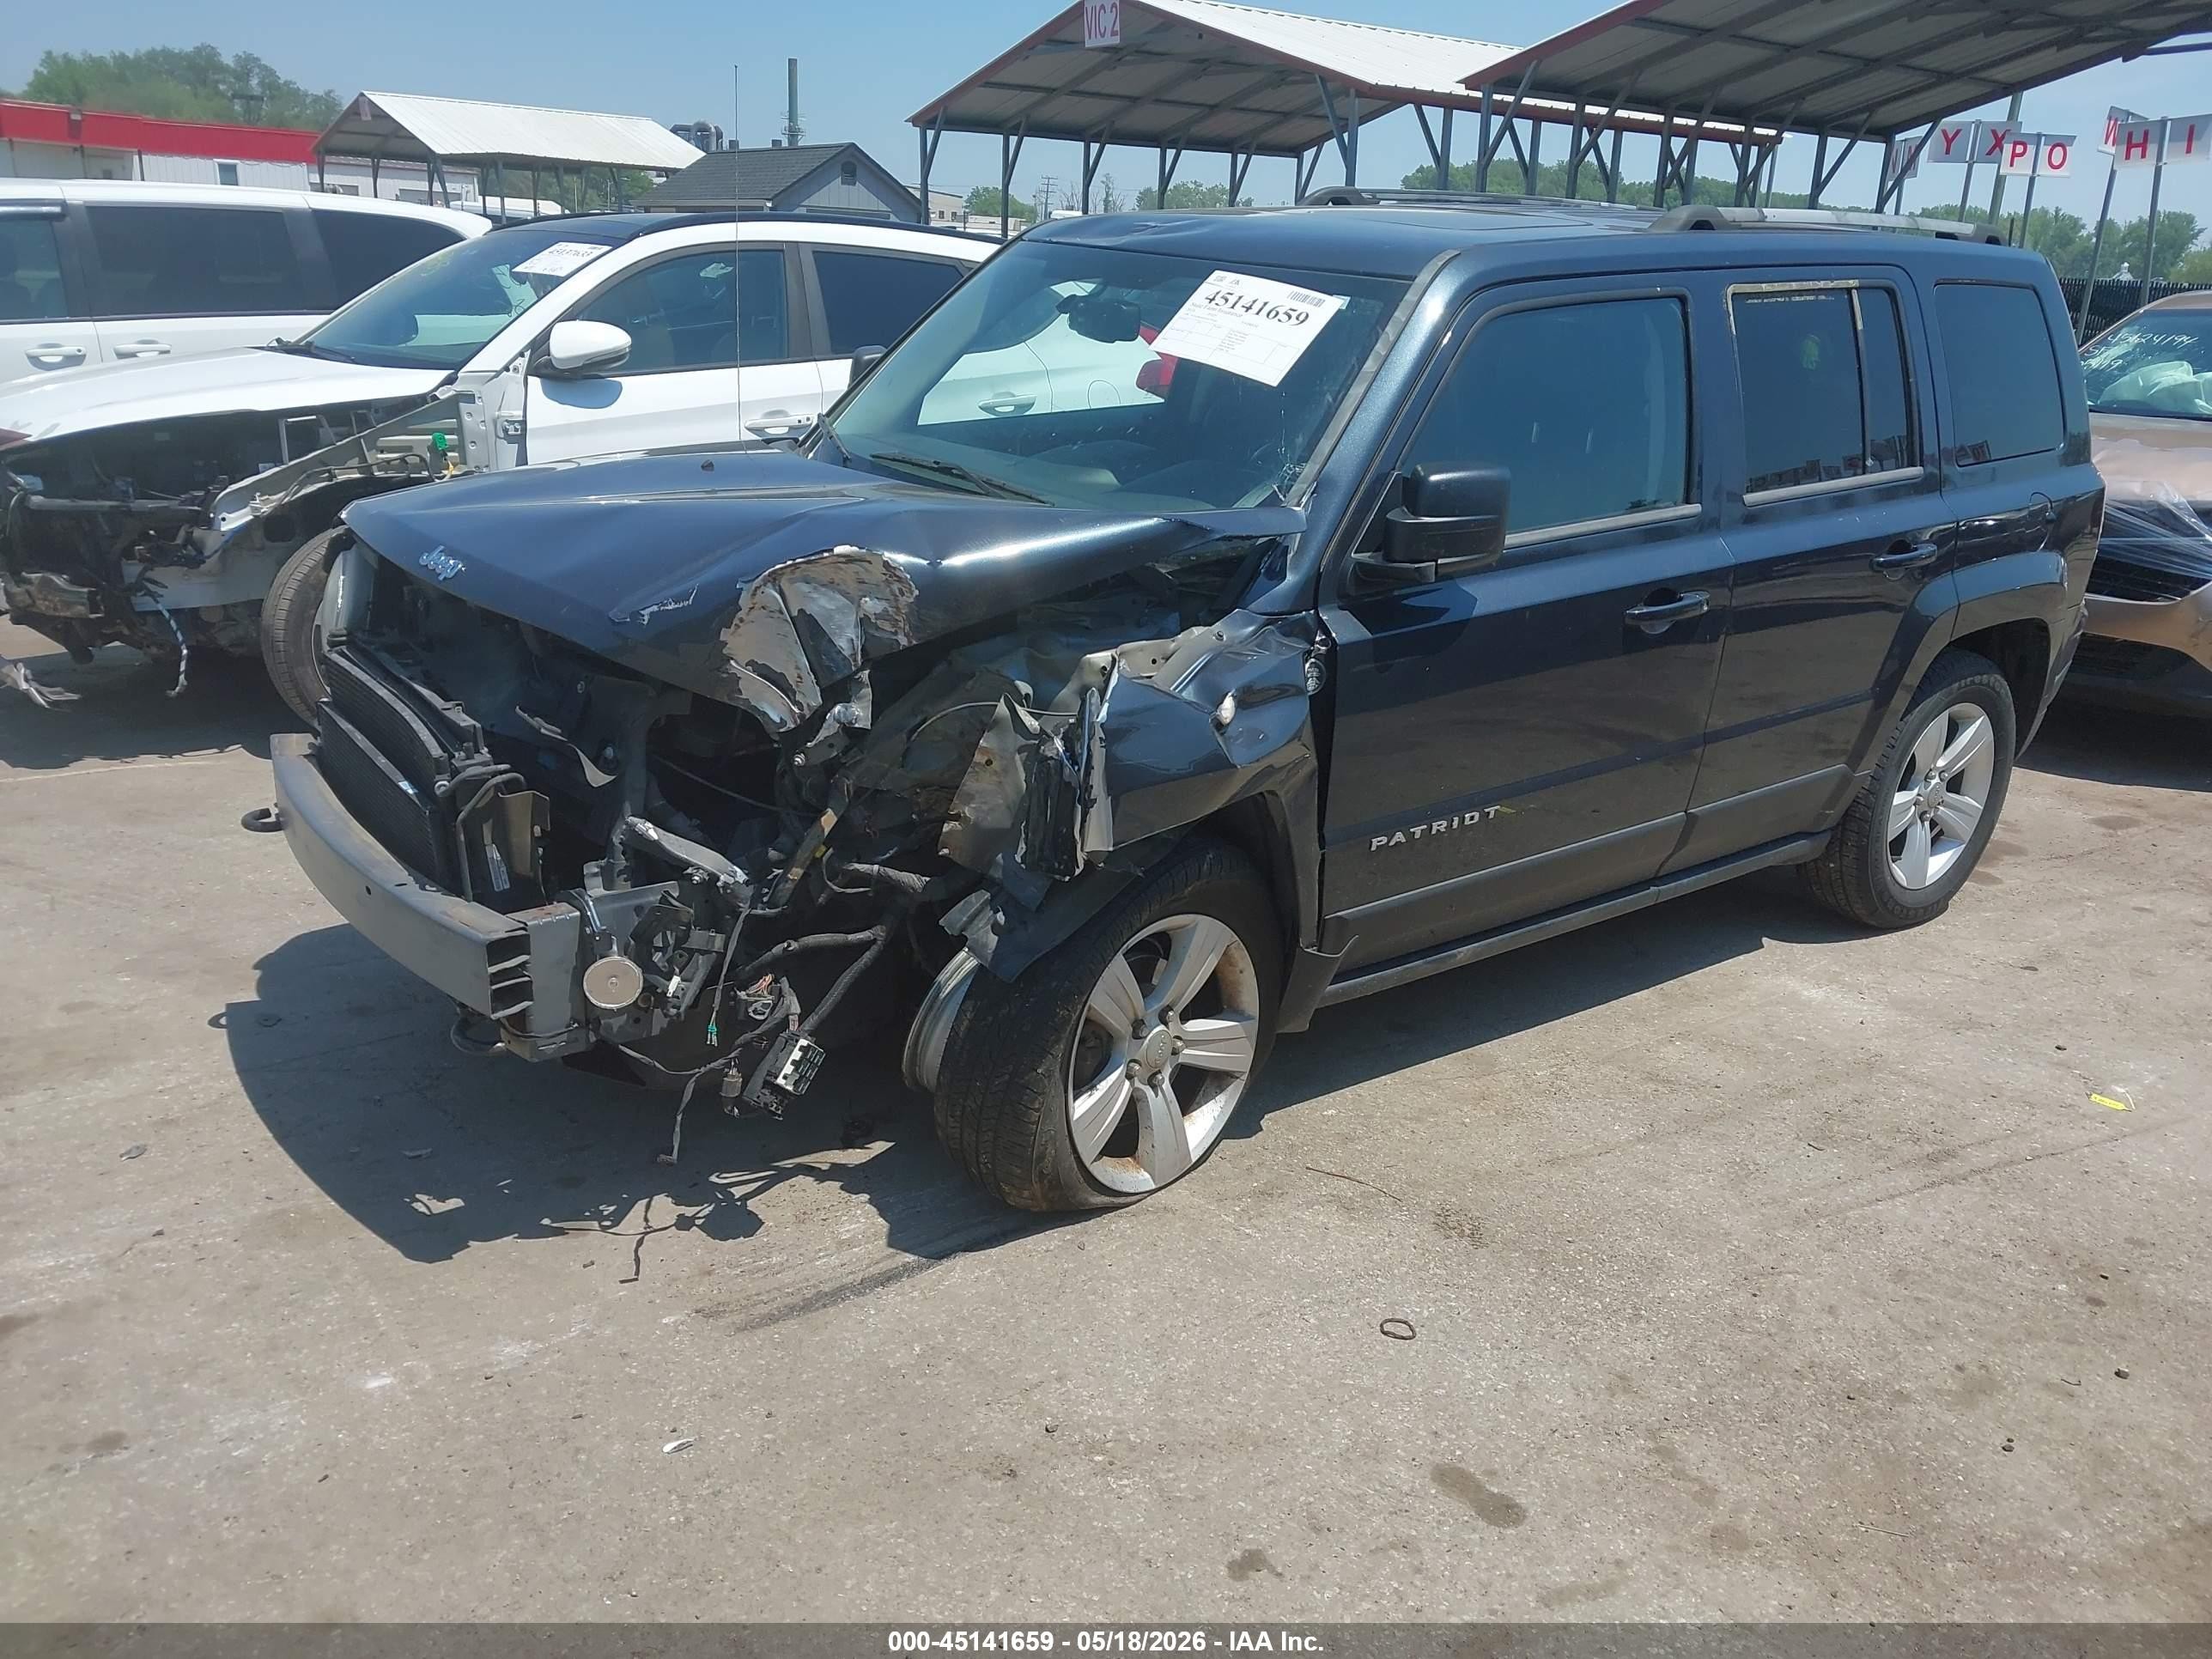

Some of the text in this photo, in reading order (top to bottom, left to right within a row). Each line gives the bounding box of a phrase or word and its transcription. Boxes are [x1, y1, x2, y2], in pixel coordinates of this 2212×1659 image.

[1085, 2, 1119, 40] VIC 2
[1941, 128, 2012, 156] Y X
[2009, 140, 2068, 170] P O
[2124, 124, 2196, 161] H I
[1204, 289, 1310, 326] 45141659
[1370, 805, 1501, 852] PATRIOT
